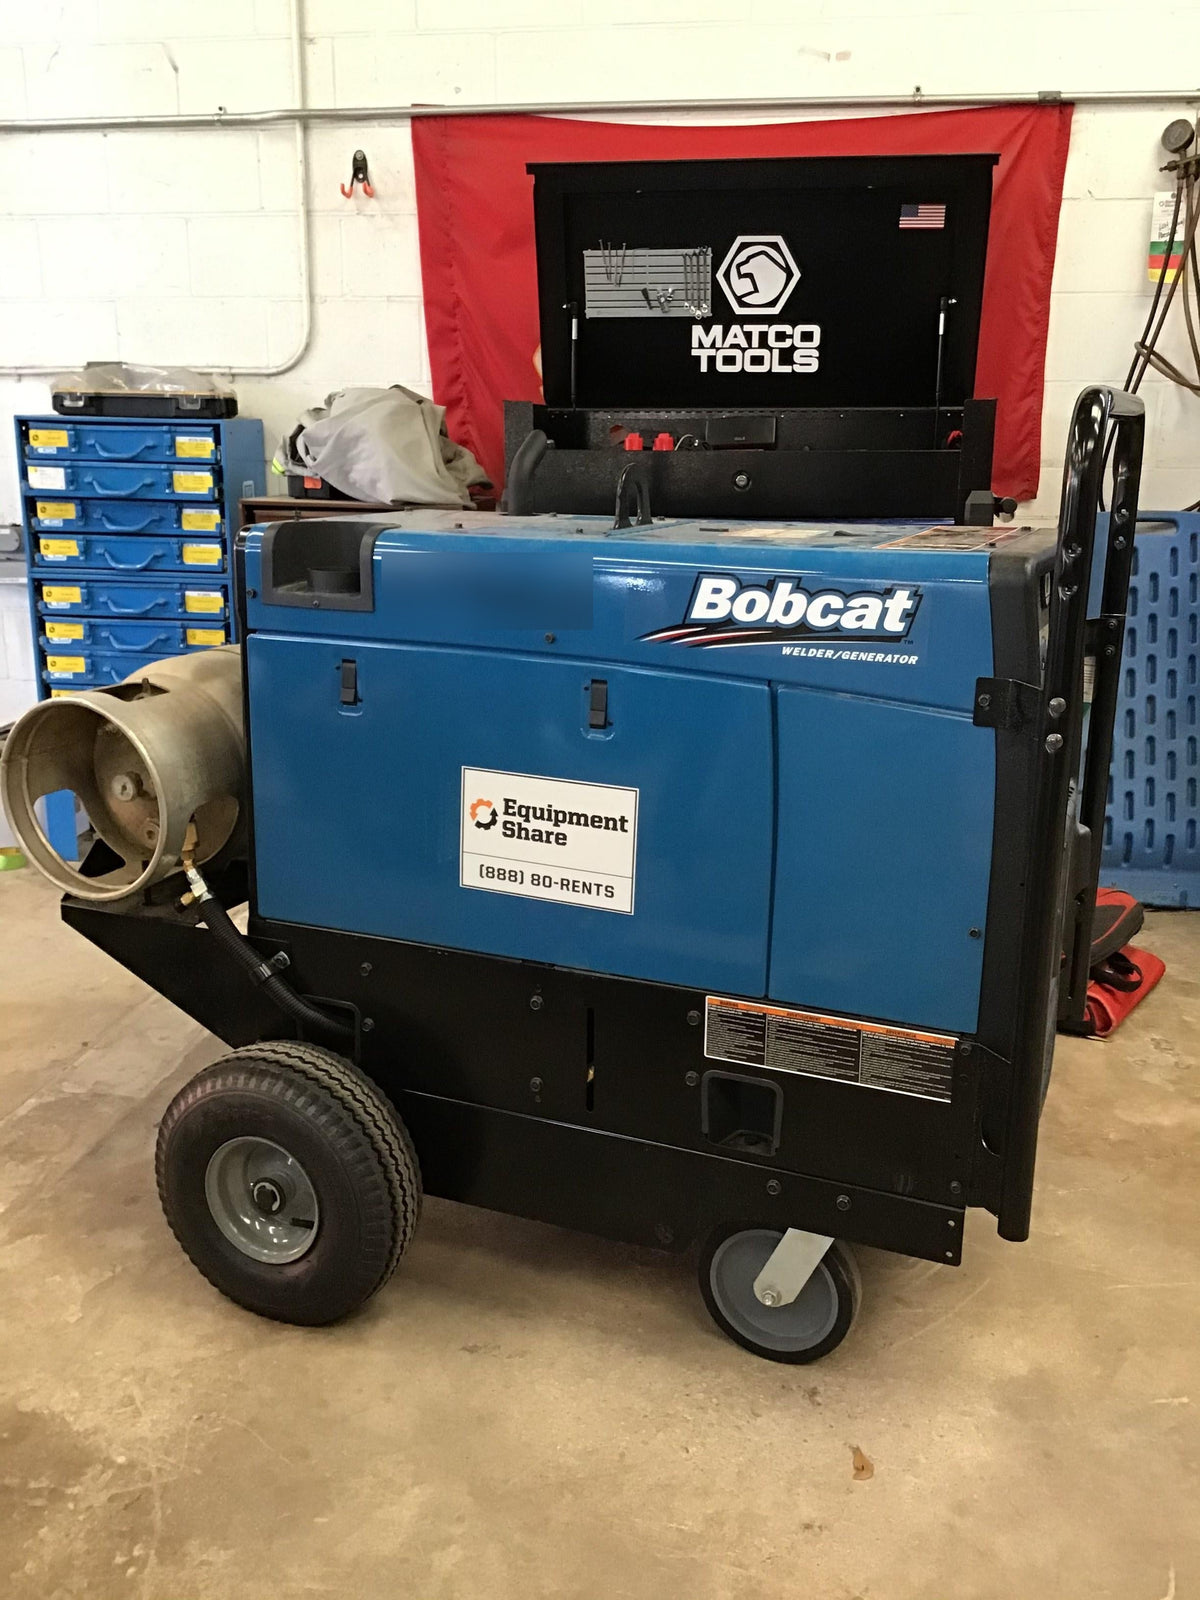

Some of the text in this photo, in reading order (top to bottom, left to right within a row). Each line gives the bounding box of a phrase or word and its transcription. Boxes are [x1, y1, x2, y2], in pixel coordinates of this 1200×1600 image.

[691, 324, 821, 348] MATCO
[691, 349, 820, 373] TOOLS
[690, 577, 914, 632] Bobcat
[781, 646, 919, 665] WELDER/GENERATOR
[503, 798, 629, 833] Equipment
[502, 820, 568, 846] Share
[479, 864, 615, 899] (888) 80-RENTS
